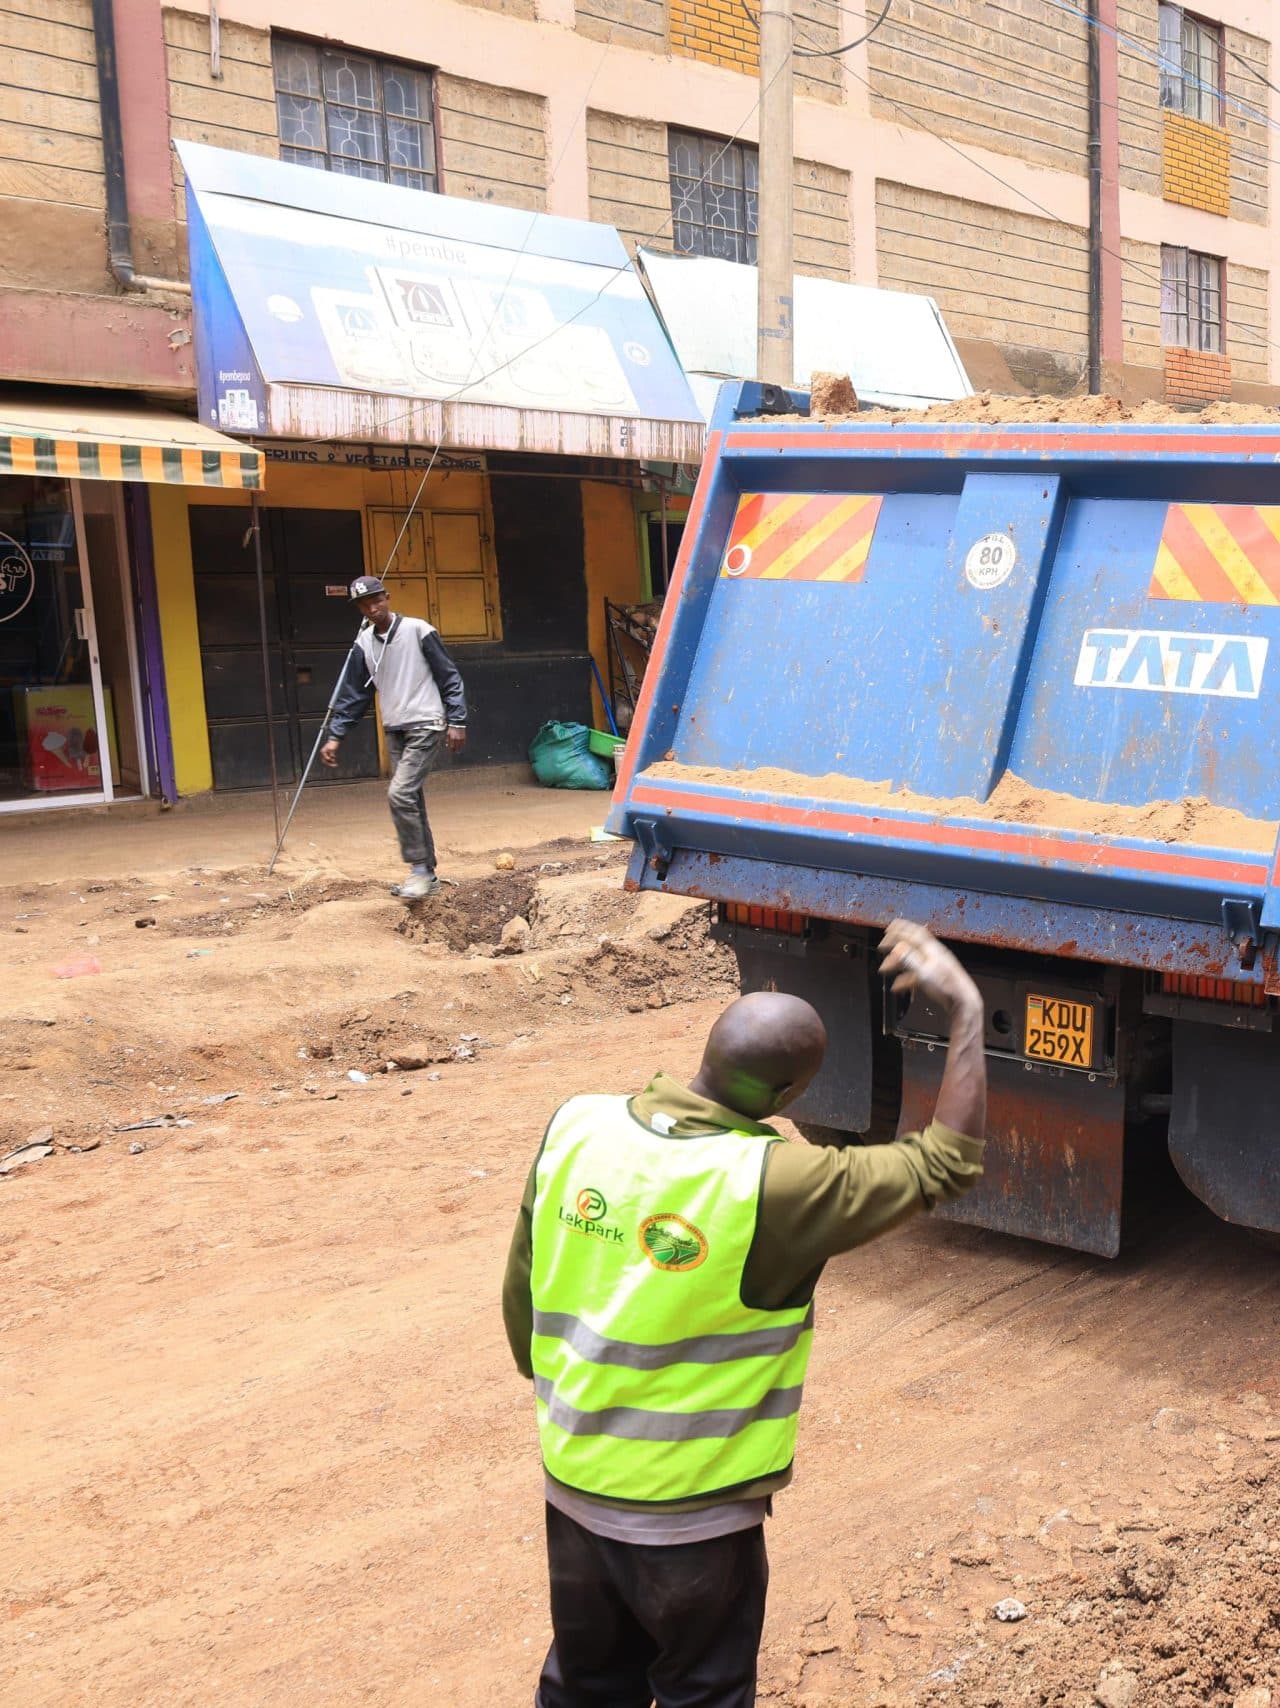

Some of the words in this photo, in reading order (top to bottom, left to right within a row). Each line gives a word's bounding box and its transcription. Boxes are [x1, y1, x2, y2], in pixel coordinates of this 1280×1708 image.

[264, 448, 318, 462] FRUITS
[328, 452, 336, 463] &
[345, 453, 432, 468] VEGETABES
[979, 567, 998, 576] KPH
[980, 546, 1003, 565] 80
[1087, 633, 1255, 693] TATA
[1042, 1000, 1087, 1033] KDU
[1029, 1028, 1085, 1064] 259X
[559, 1205, 624, 1243] Lekpark
